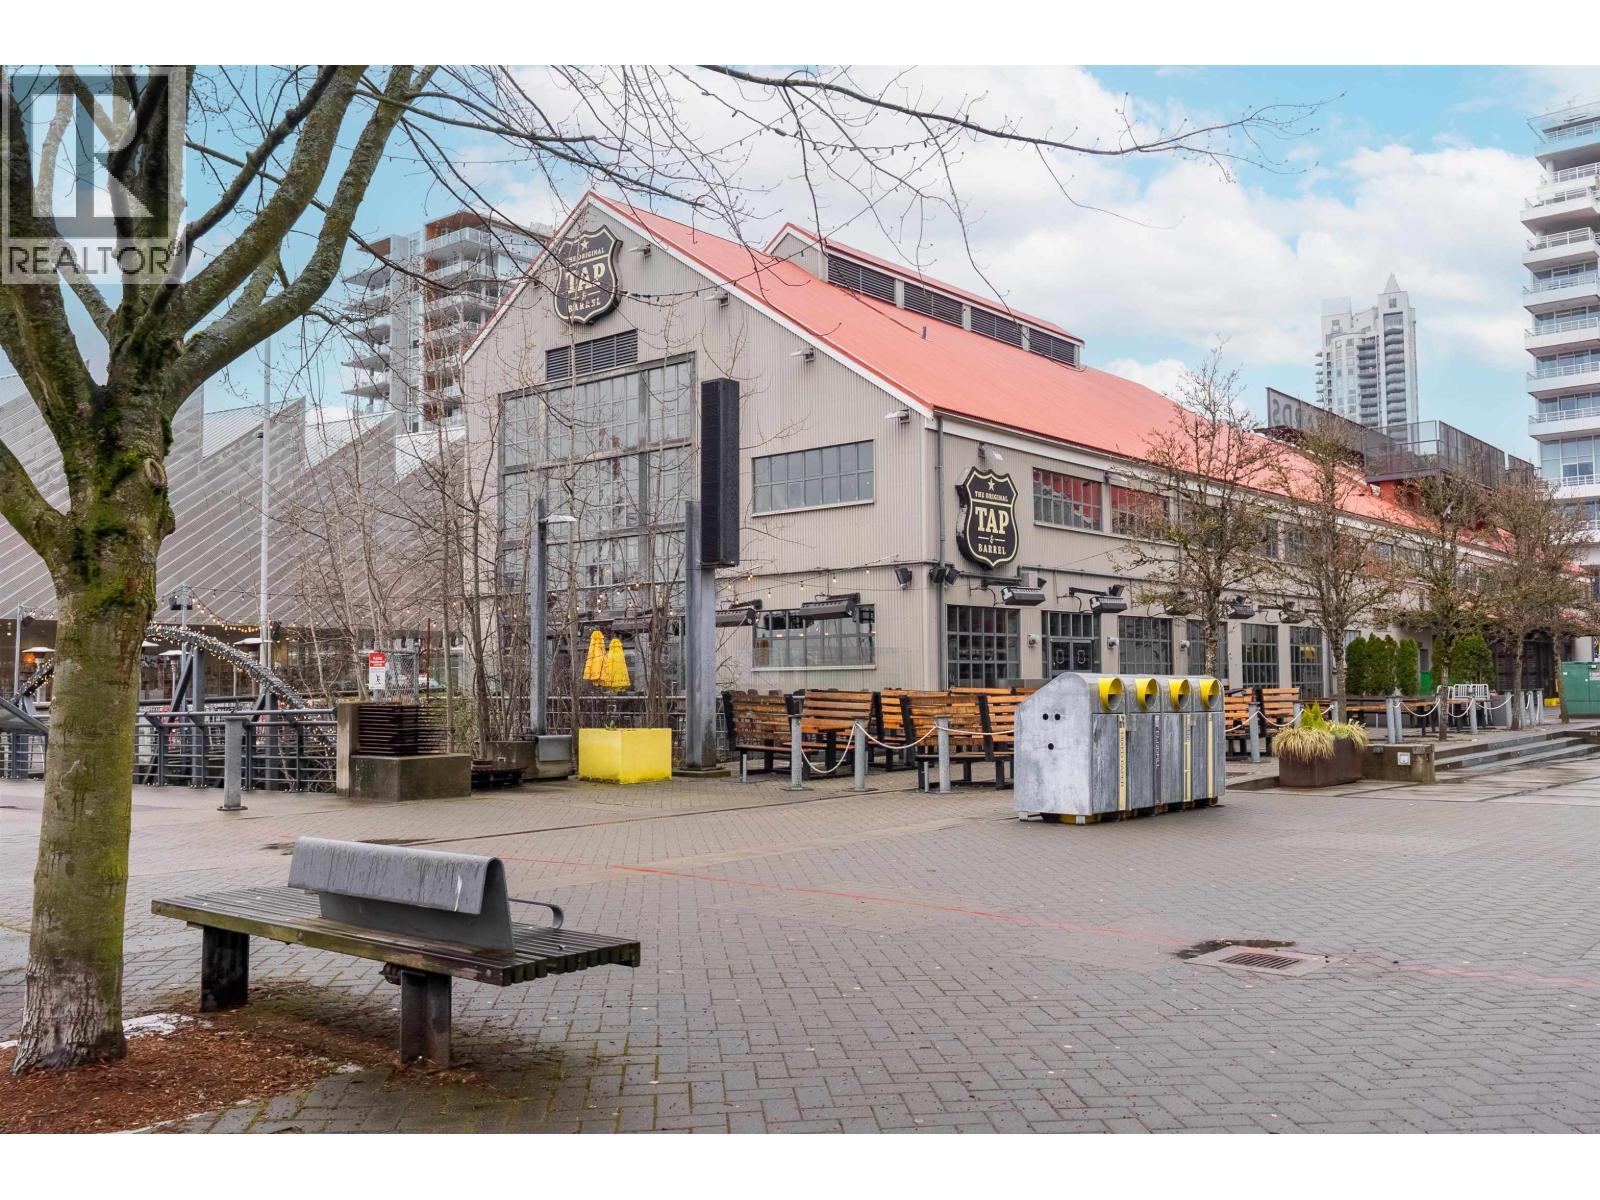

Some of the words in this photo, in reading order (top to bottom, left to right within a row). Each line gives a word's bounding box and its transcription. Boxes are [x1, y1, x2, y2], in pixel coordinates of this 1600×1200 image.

[565, 262, 606, 294] TAP
[974, 490, 985, 499] THE
[985, 492, 1009, 502] ORIGINAL
[975, 506, 1010, 535] TAP
[978, 543, 1007, 555] BARREL
